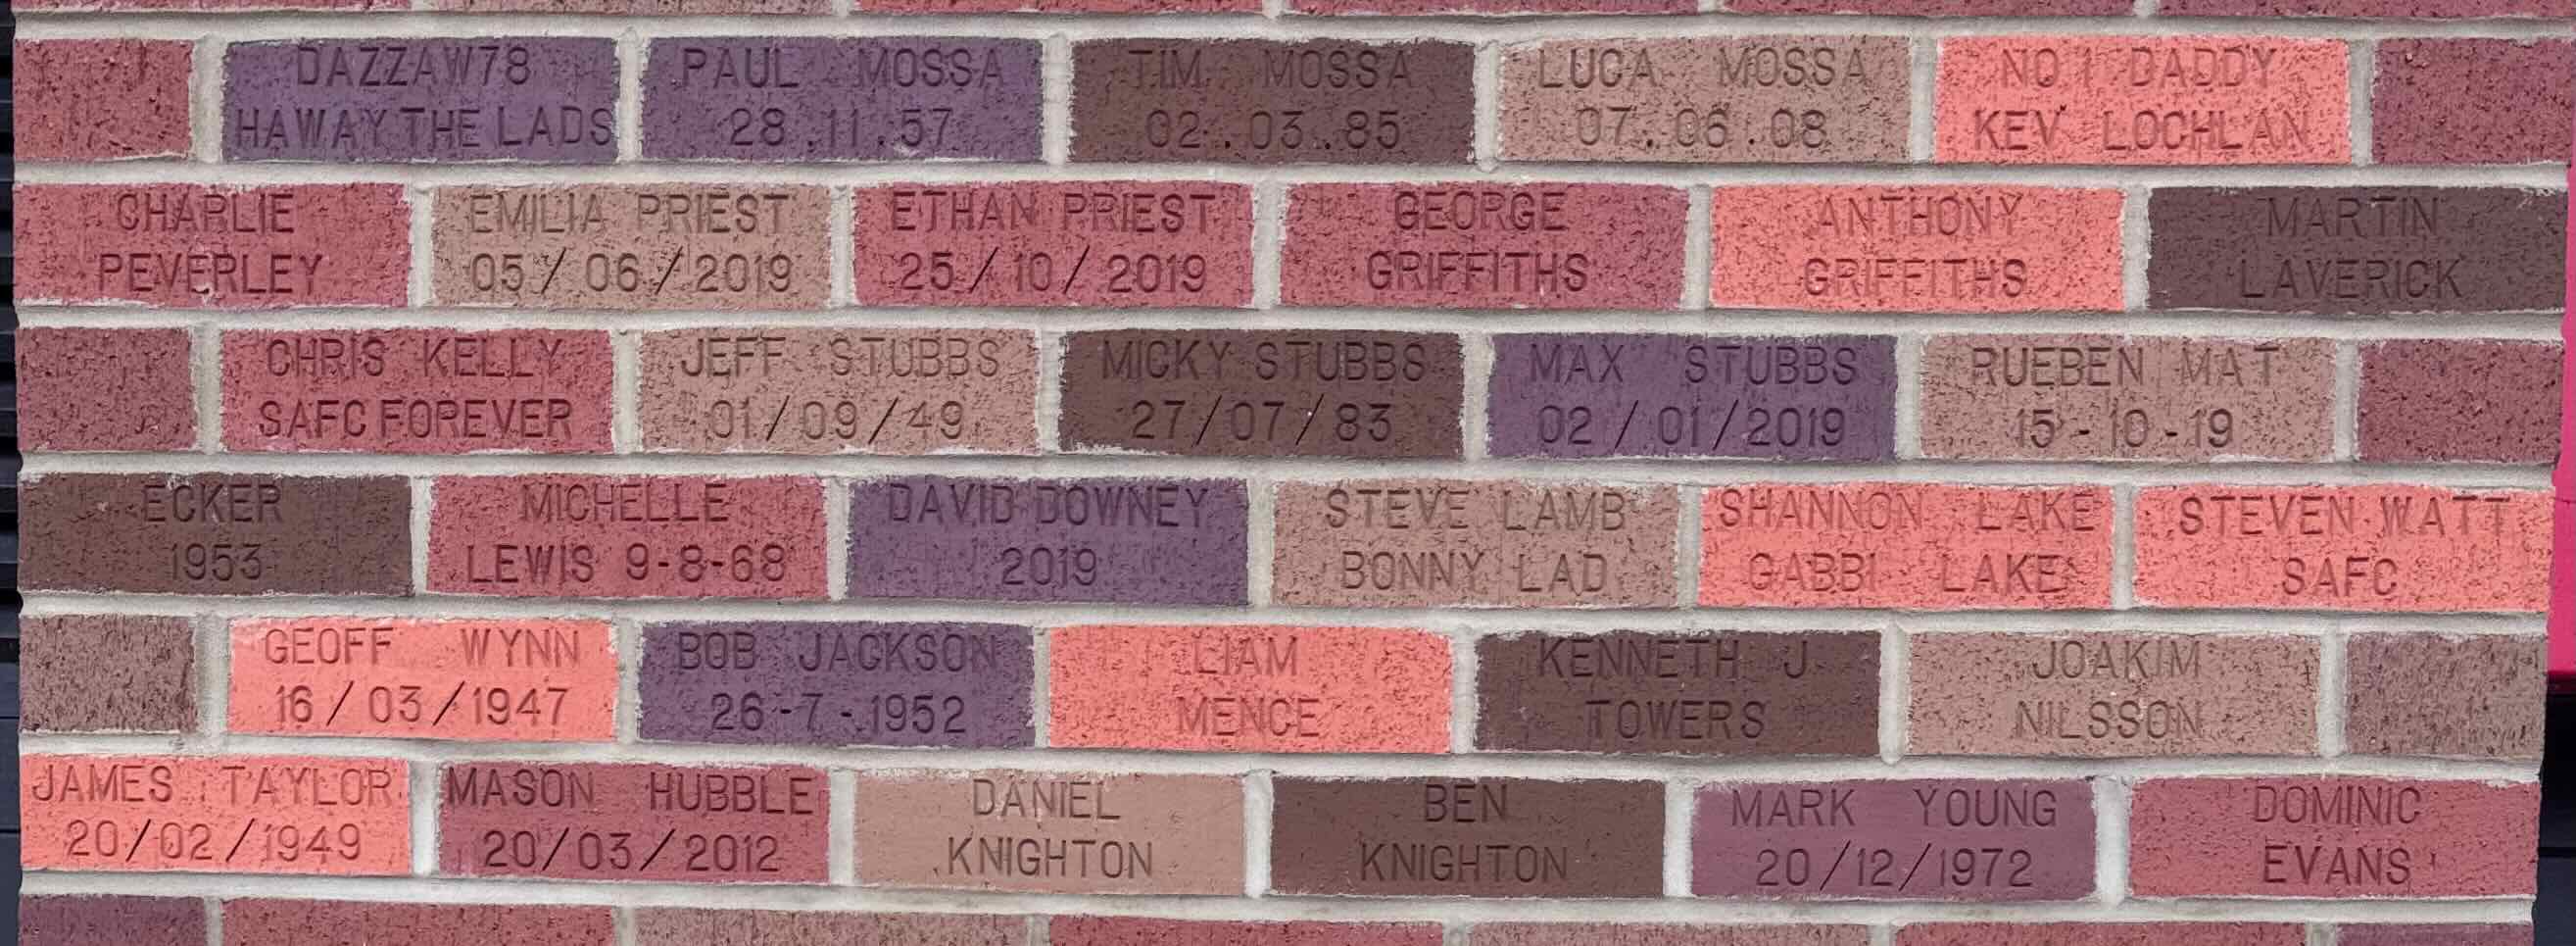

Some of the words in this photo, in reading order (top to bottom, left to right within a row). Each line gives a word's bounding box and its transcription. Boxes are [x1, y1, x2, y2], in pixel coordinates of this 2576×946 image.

[298, 47, 531, 87] DAZZAW78
[683, 48, 800, 88] PAUL
[859, 48, 1003, 88] MOSSA
[1129, 49, 1202, 89] TIM
[1263, 49, 1413, 89] MOSSA
[1537, 48, 1657, 88] LUCA
[1719, 47, 1867, 88] MOSSA
[2128, 47, 2277, 90] DADDY
[237, 108, 386, 149] HAWAY
[399, 106, 481, 147] THE
[497, 108, 614, 147] LADS
[1973, 110, 2063, 151] KEV
[2104, 111, 2309, 151] LOCHLAN
[117, 193, 295, 233] CHARLIE
[469, 195, 606, 235] EMILIA
[639, 195, 790, 235] PRIEST
[891, 191, 1037, 232] ETHAN
[1063, 194, 1216, 234] PRIEST
[1394, 192, 1568, 232] GEORGE
[1819, 195, 2022, 236] ANTHONY
[2267, 197, 2442, 237] MARTIN
[99, 254, 323, 295] PEVERLEY
[1367, 252, 1590, 293] GRIFFITHS
[1803, 258, 2028, 298] GRIFFITHS
[2240, 259, 2463, 299] LAVERICK
[267, 337, 387, 377] CHRIS
[423, 338, 565, 377] KELLY
[680, 336, 786, 376] JEFF
[828, 336, 1000, 377] STUBBS
[1100, 339, 1234, 380] MICKY
[1254, 339, 1428, 381] STUBBS
[1529, 343, 1625, 384] MAX
[1684, 345, 1858, 386] STUBBS
[1971, 346, 2144, 387] RUEBEN
[2179, 347, 2279, 389] MAT
[259, 399, 367, 438] SAFC
[380, 399, 573, 439] FOREVER
[143, 483, 284, 523] ECKER
[520, 483, 728, 523] MICHELLE
[887, 483, 1014, 524] DAVID
[1038, 486, 1210, 527] DOWNEY
[1325, 488, 1472, 530] STEVE
[1502, 490, 1627, 531] LAMB
[1719, 488, 1923, 531] SHANNON
[1979, 490, 2096, 531] LAKE
[2178, 492, 2356, 535] STEVEN
[2379, 495, 2510, 536] WATT
[171, 540, 264, 582] 1953
[467, 543, 595, 585] LEWIS
[1001, 547, 1098, 588] 2019
[1341, 550, 1484, 591] BONNY
[1519, 552, 1609, 593] LAD
[1748, 551, 1876, 593] GABBI
[1942, 552, 2068, 594] LAKE
[2281, 556, 2400, 598] SAFC
[263, 627, 394, 667] GEOFF
[459, 627, 581, 669] WYNN
[677, 631, 757, 672] BOB
[799, 632, 997, 673] JACKSON
[1193, 634, 1298, 677] LIAM
[1536, 638, 1741, 678] KENNETH
[1781, 639, 1808, 680] J
[2029, 639, 2203, 682] JOAKIM
[1176, 696, 1322, 737] MENCE
[1584, 699, 1766, 740] TOWERS
[2014, 700, 2201, 740] NILSSON
[30, 764, 174, 804] JAMES
[219, 765, 394, 807] TAYLOR
[444, 767, 595, 808] MASON
[646, 772, 815, 816] HUBBLE
[972, 778, 1122, 822] DANIEL
[1424, 783, 1508, 824] BEN
[2254, 784, 2423, 825] DOMINIC
[1729, 788, 1857, 828] MARK
[1911, 788, 2059, 827] YOUNG
[947, 836, 1154, 880] KNIGHTON
[1357, 840, 1569, 884] KNIGHTON
[2261, 844, 2412, 886] EVANS
